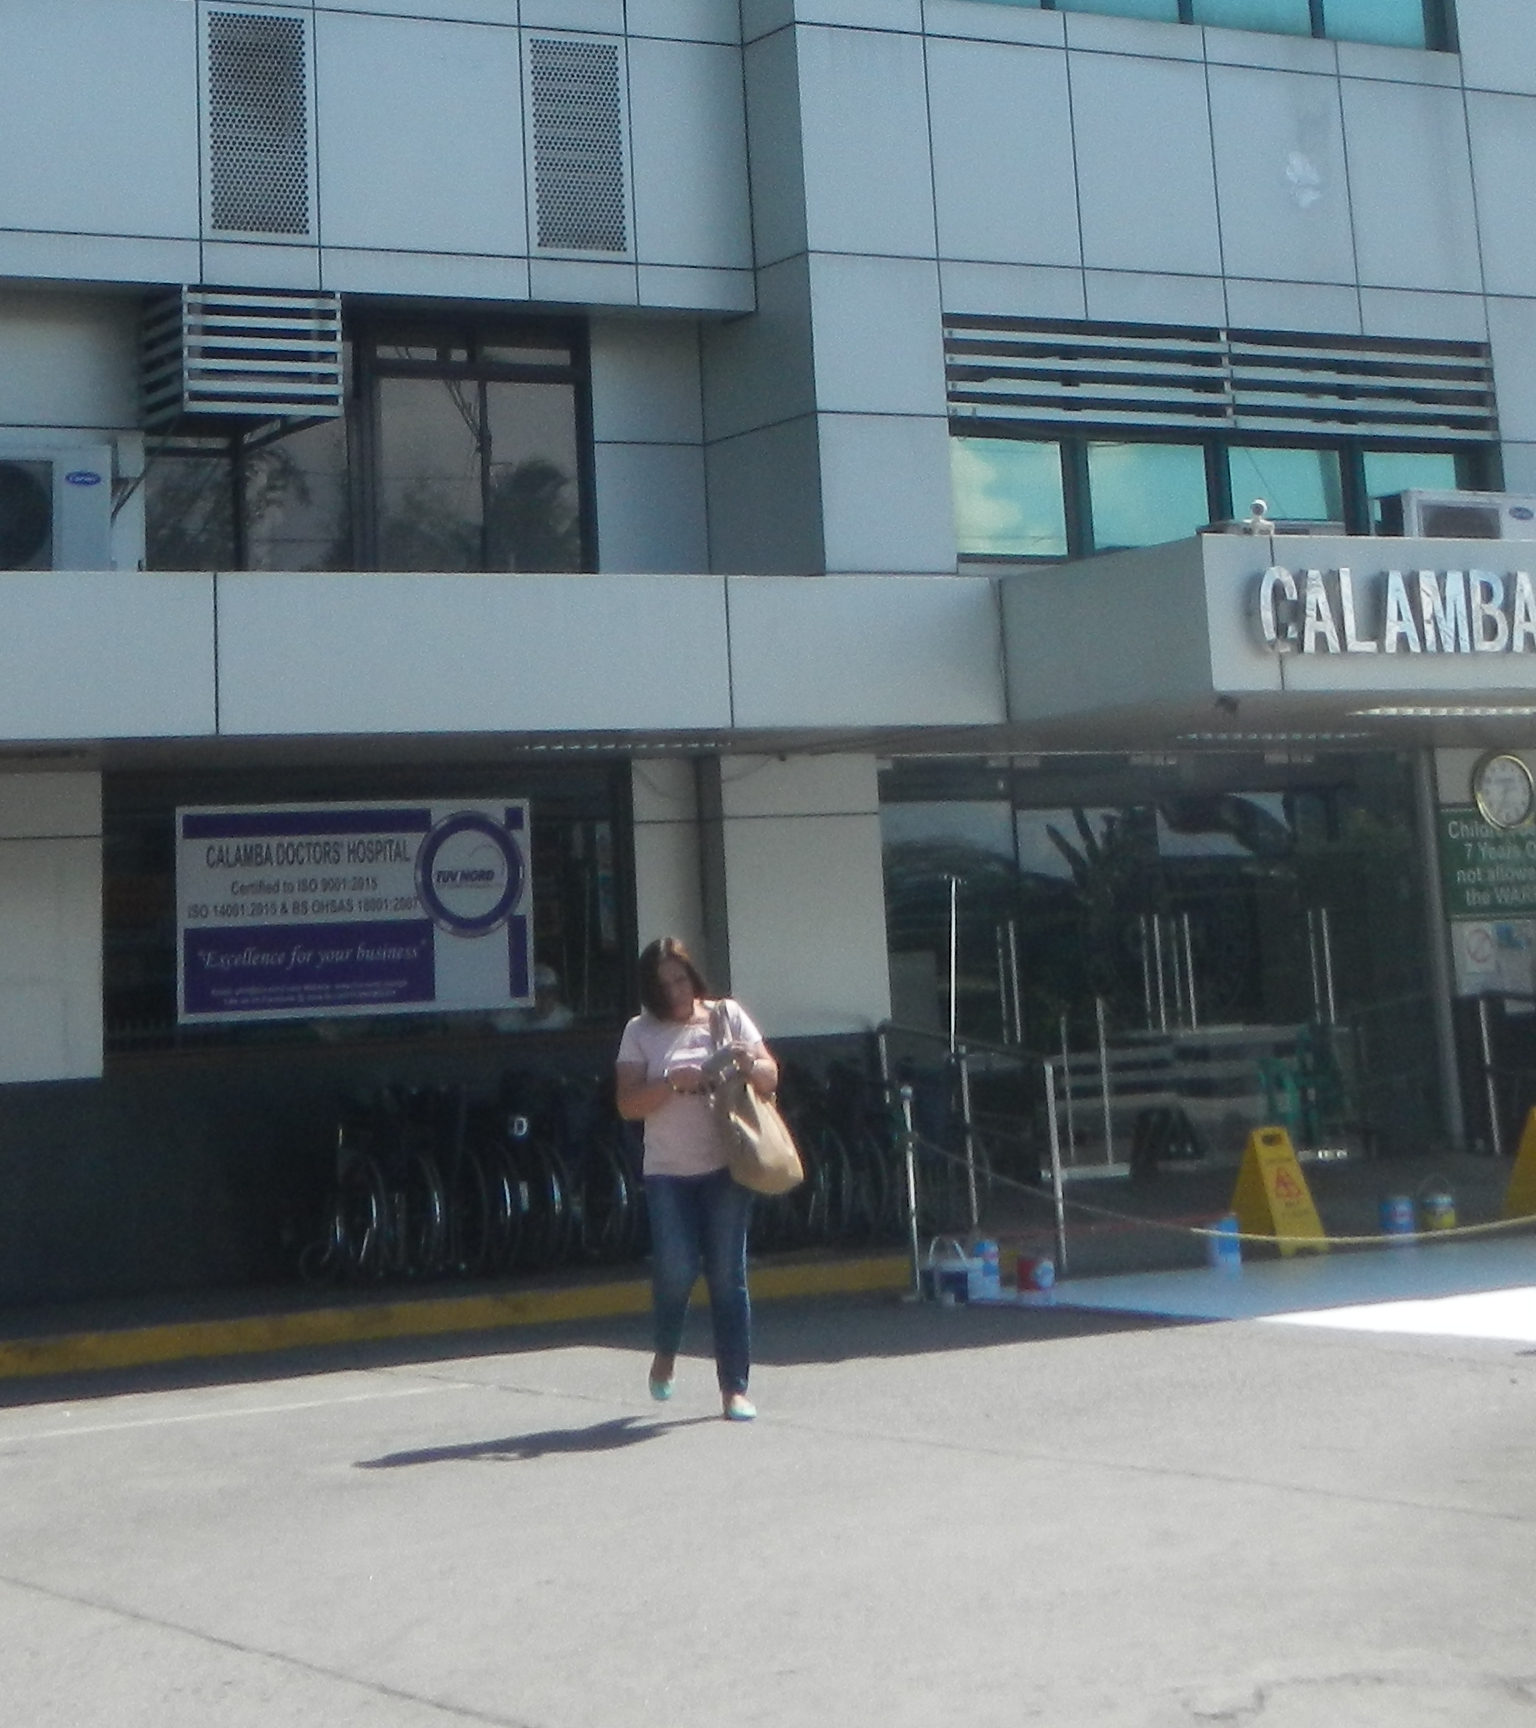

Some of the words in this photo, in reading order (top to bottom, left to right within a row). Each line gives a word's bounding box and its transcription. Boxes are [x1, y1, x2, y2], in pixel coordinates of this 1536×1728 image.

[206, 843, 272, 868] CALAMBA
[347, 839, 411, 864] HOSPITAL
[1464, 842, 1473, 860] 7
[1456, 867, 1482, 884] not
[231, 879, 280, 895] Certified
[283, 880, 294, 893] to
[297, 878, 318, 893] ISO
[1465, 887, 1490, 906] the
[188, 904, 209, 919] ISO
[287, 944, 313, 970] for
[317, 948, 353, 969] your
